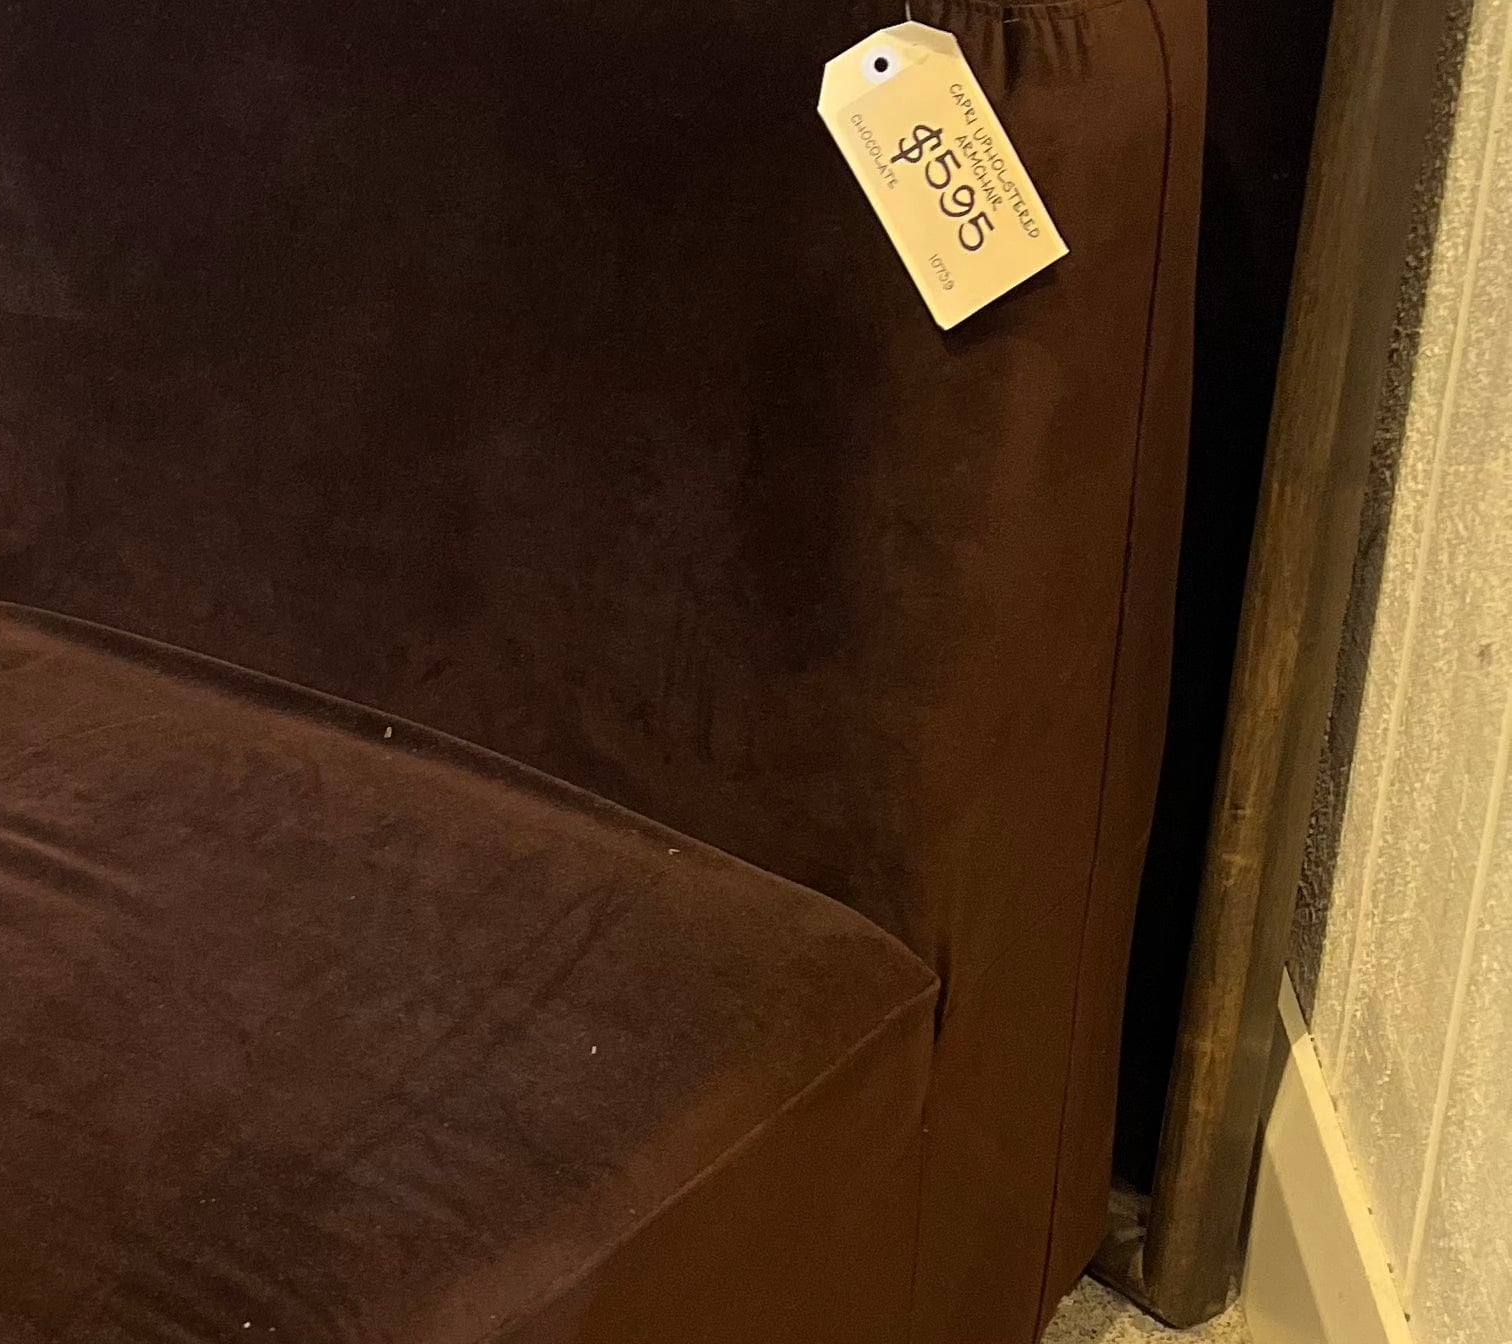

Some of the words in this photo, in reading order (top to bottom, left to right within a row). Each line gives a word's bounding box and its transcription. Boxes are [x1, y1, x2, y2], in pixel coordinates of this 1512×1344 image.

[849, 113, 901, 191] CHOCOLATE
[890, 124, 995, 252] $595
[949, 83, 978, 125] CAPRI
[973, 126, 1041, 238] UPHOLSTERED
[955, 134, 1003, 212] ARMCHAIR
